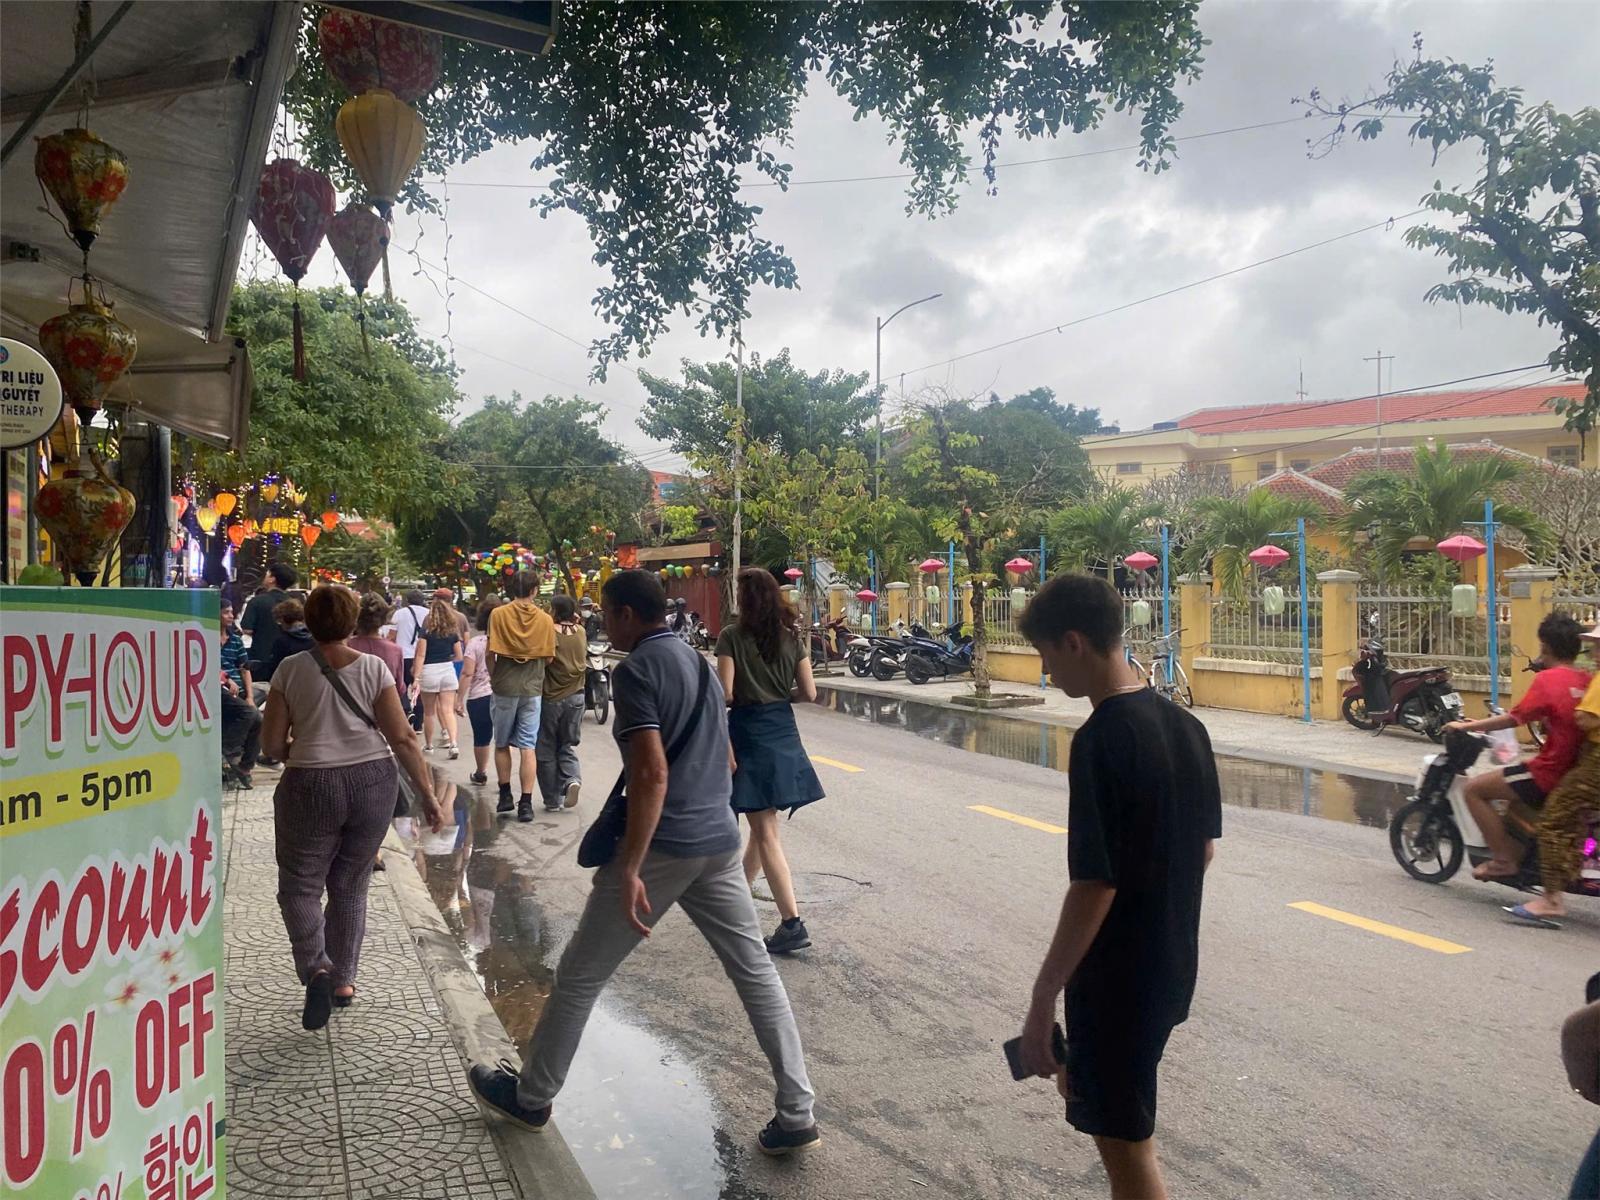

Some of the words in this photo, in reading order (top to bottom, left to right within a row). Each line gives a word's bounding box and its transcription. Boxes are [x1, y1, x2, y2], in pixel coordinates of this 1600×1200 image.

[0, 370, 14, 386] RỊ
[0, 387, 40, 404] GUYỆT
[1, 404, 44, 416] THERAPY
[81, 768, 152, 811] 5pm
[135, 973, 214, 1109] OFF
